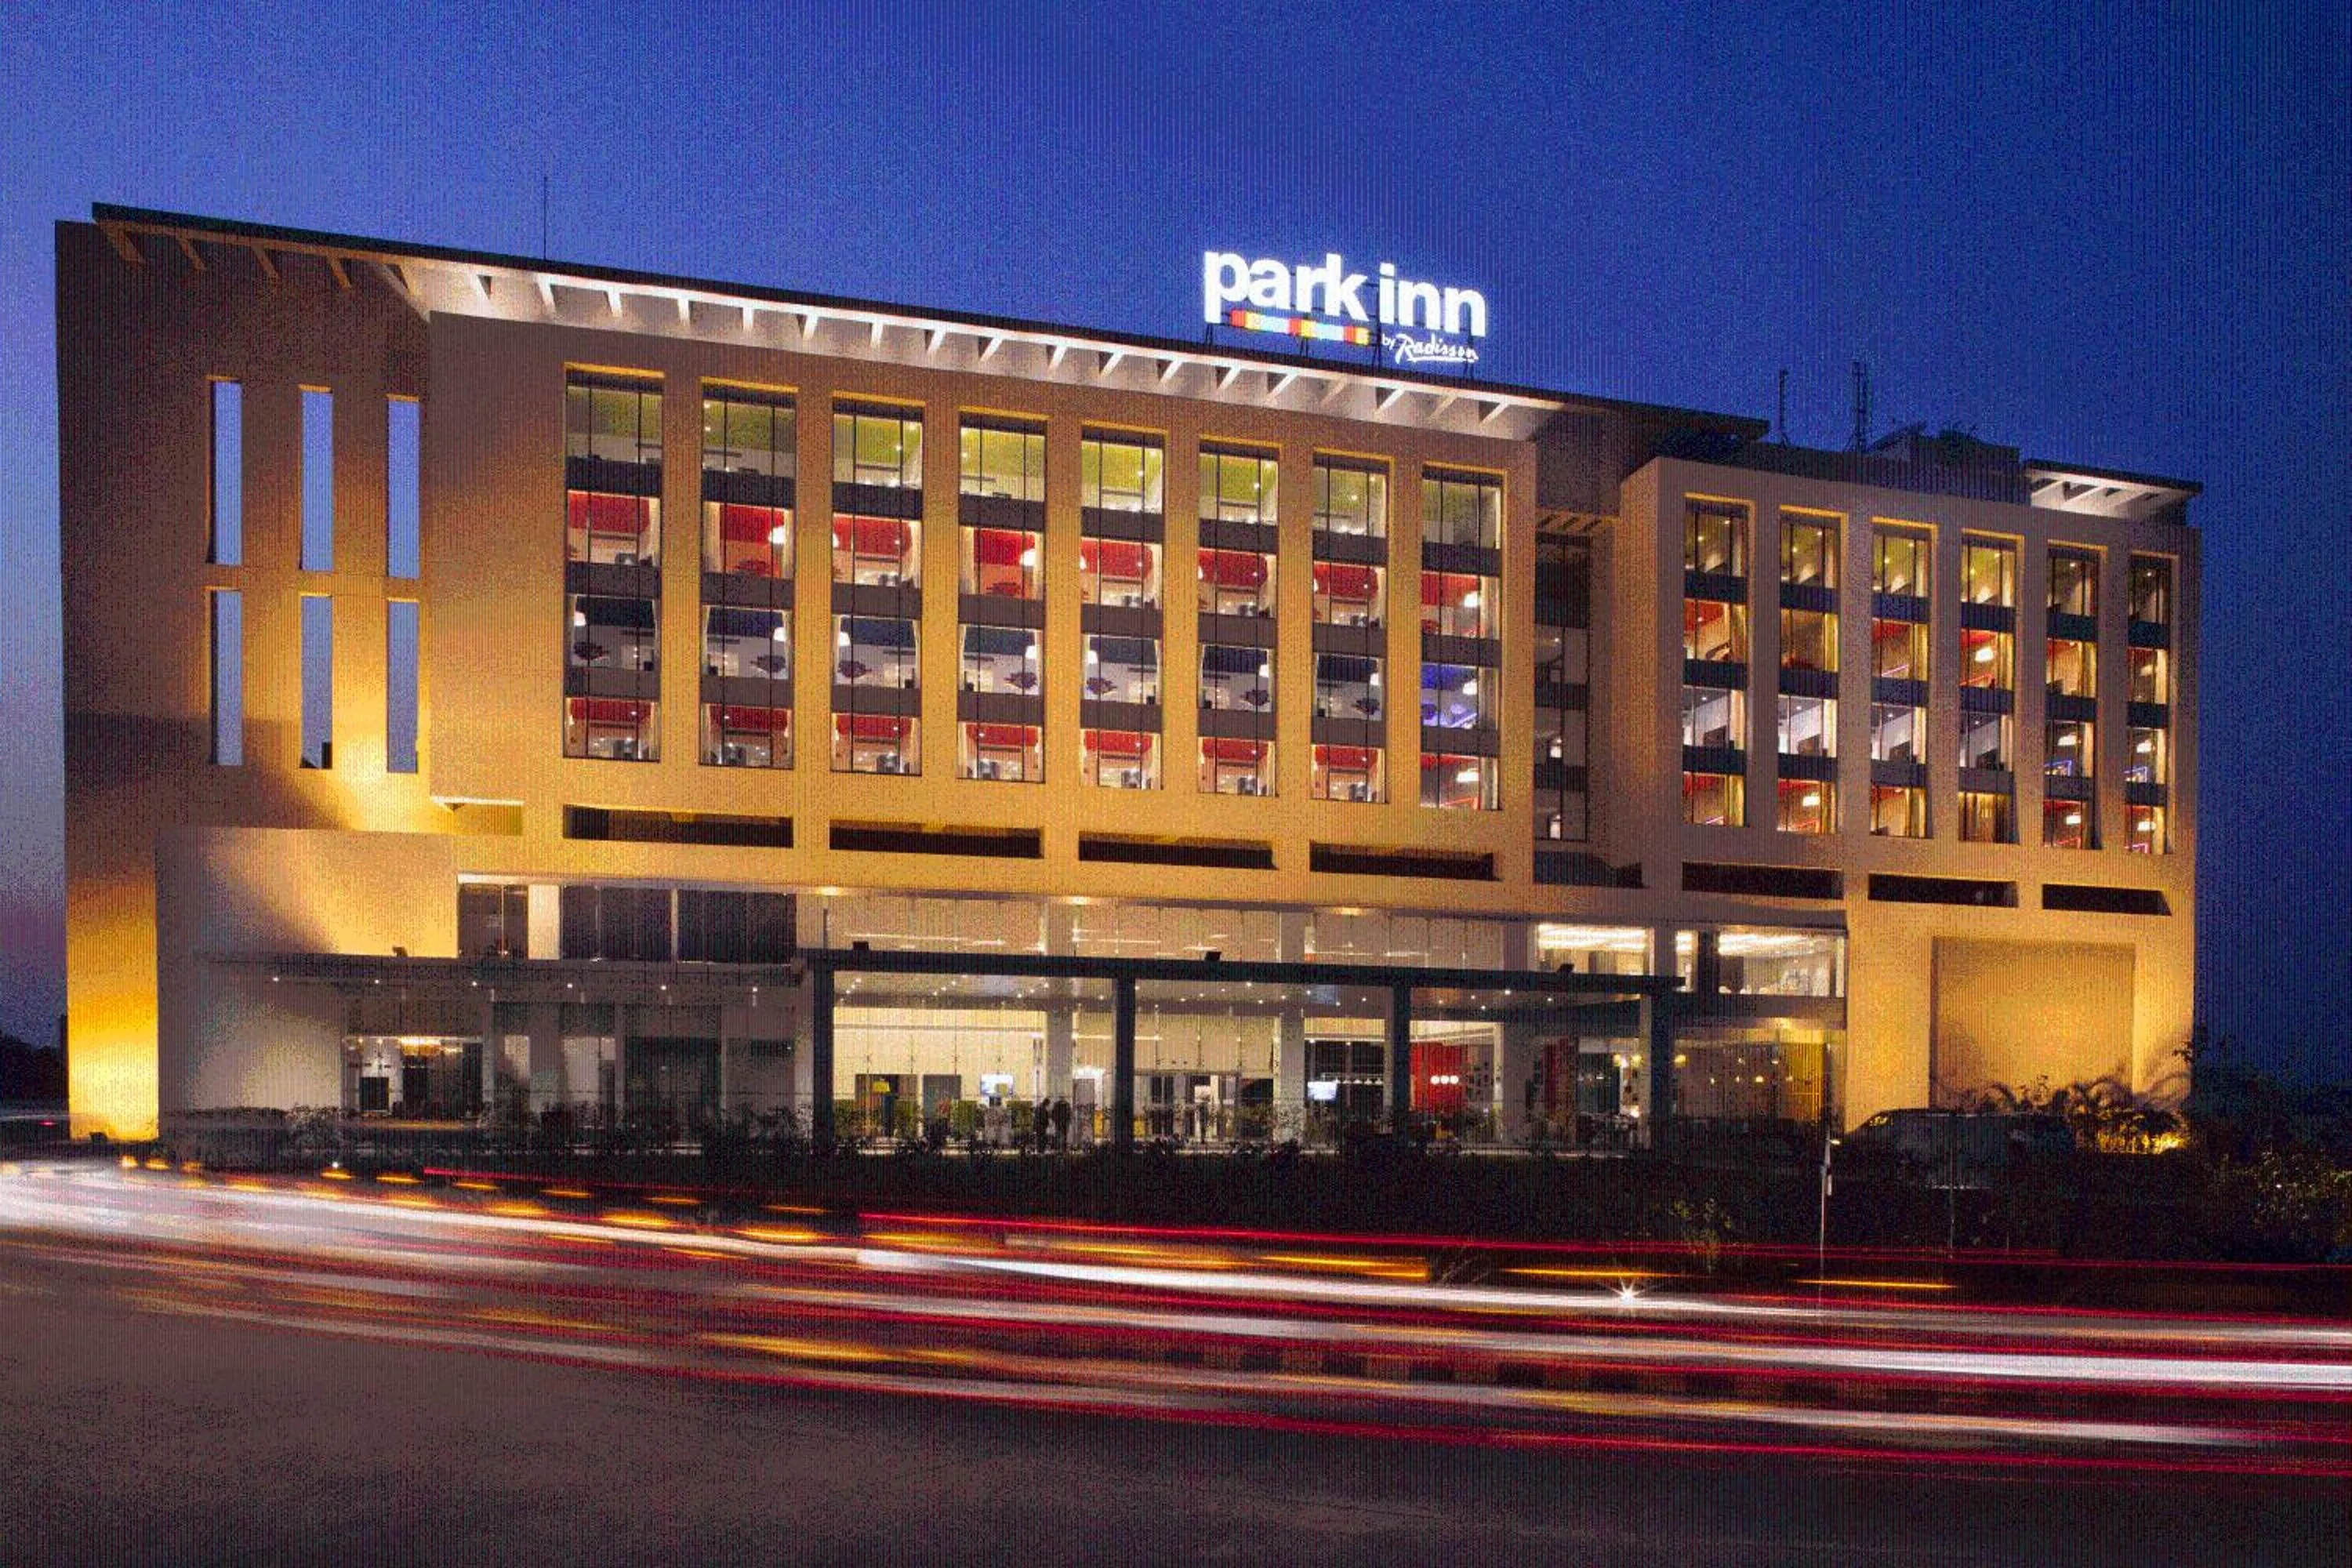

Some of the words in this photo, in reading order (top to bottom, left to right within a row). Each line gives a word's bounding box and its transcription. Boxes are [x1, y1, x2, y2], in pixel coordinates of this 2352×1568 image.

[1203, 251, 1370, 324] park
[1378, 262, 1486, 337] inn
[1382, 335, 1396, 350] by
[1396, 333, 1478, 364] Radisson
